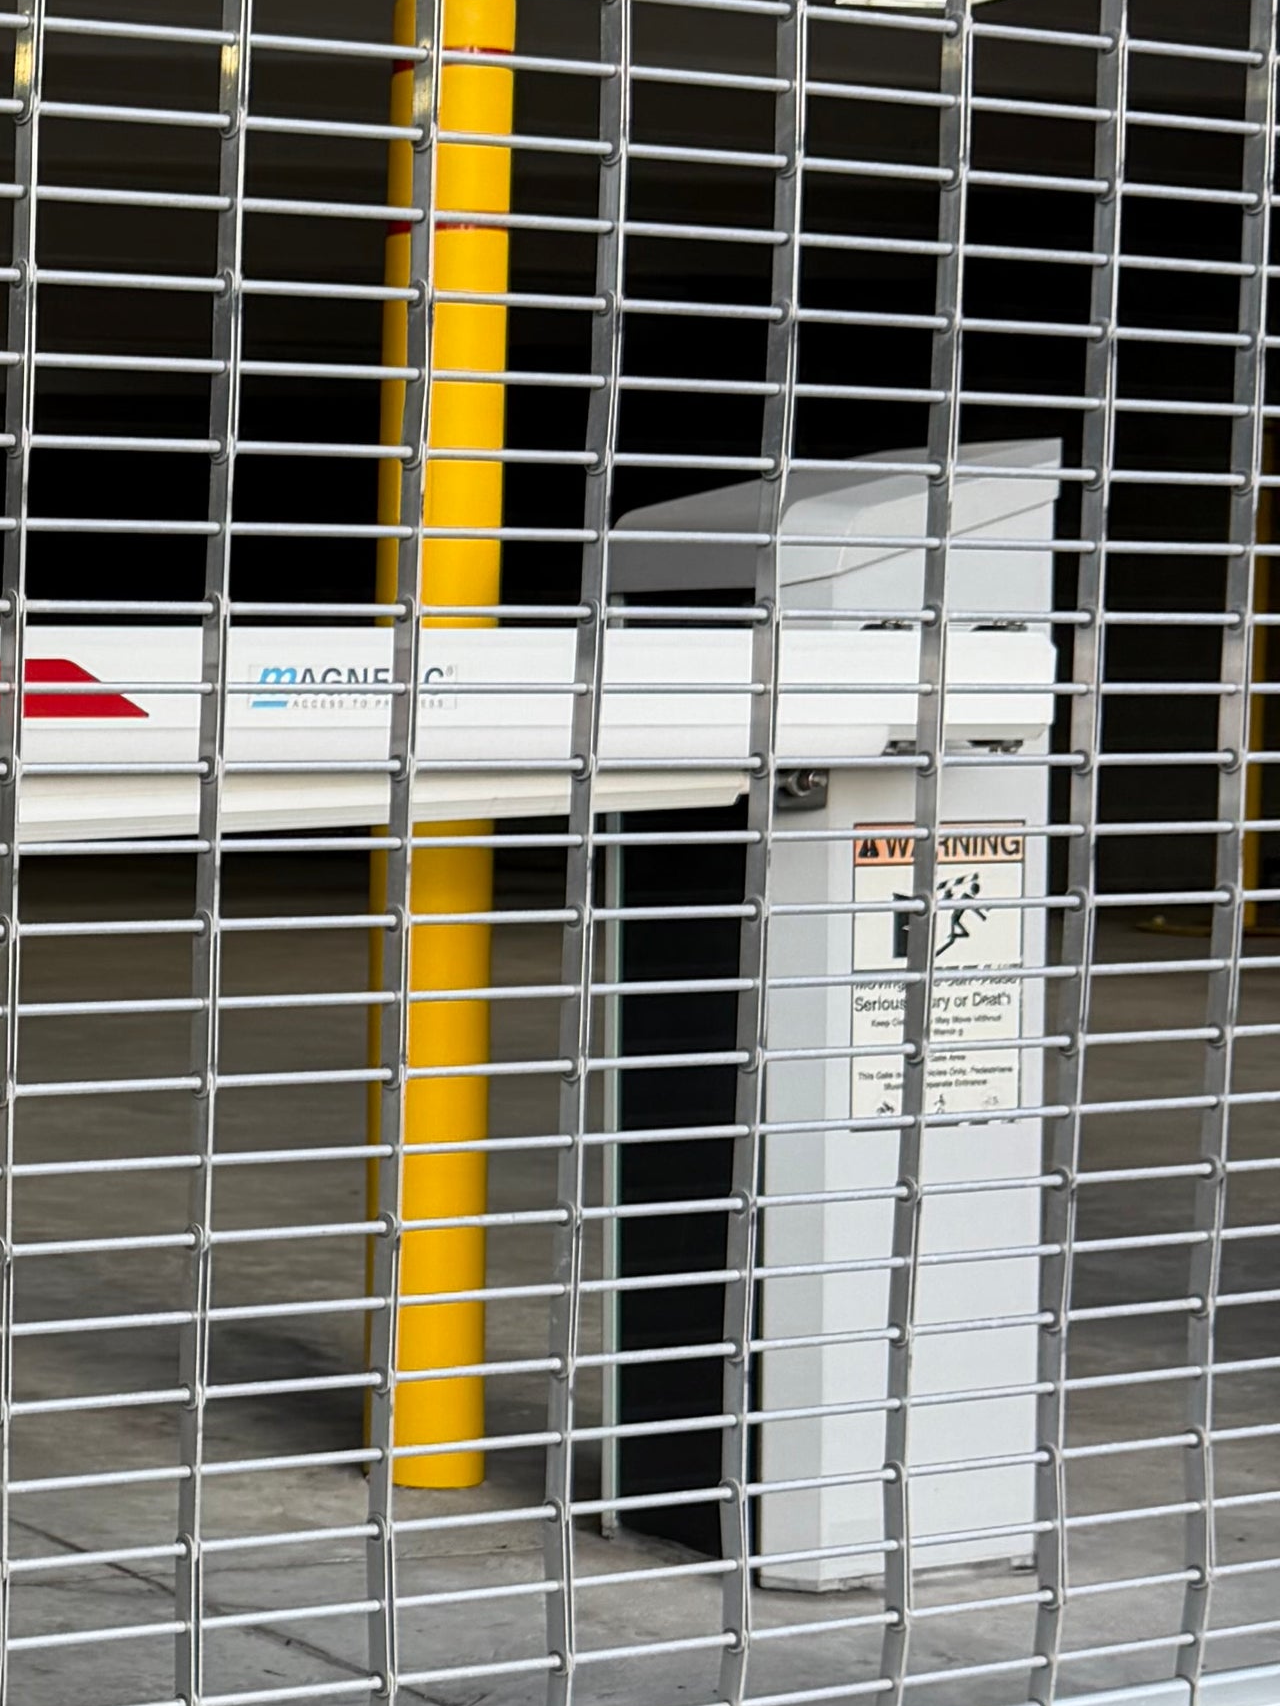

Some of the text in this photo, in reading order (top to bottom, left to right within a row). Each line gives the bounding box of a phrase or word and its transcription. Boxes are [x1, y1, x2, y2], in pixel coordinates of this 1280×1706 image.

[886, 834, 1020, 859] WRNING
[953, 995, 968, 1008] or
[972, 991, 1012, 1007] Death
